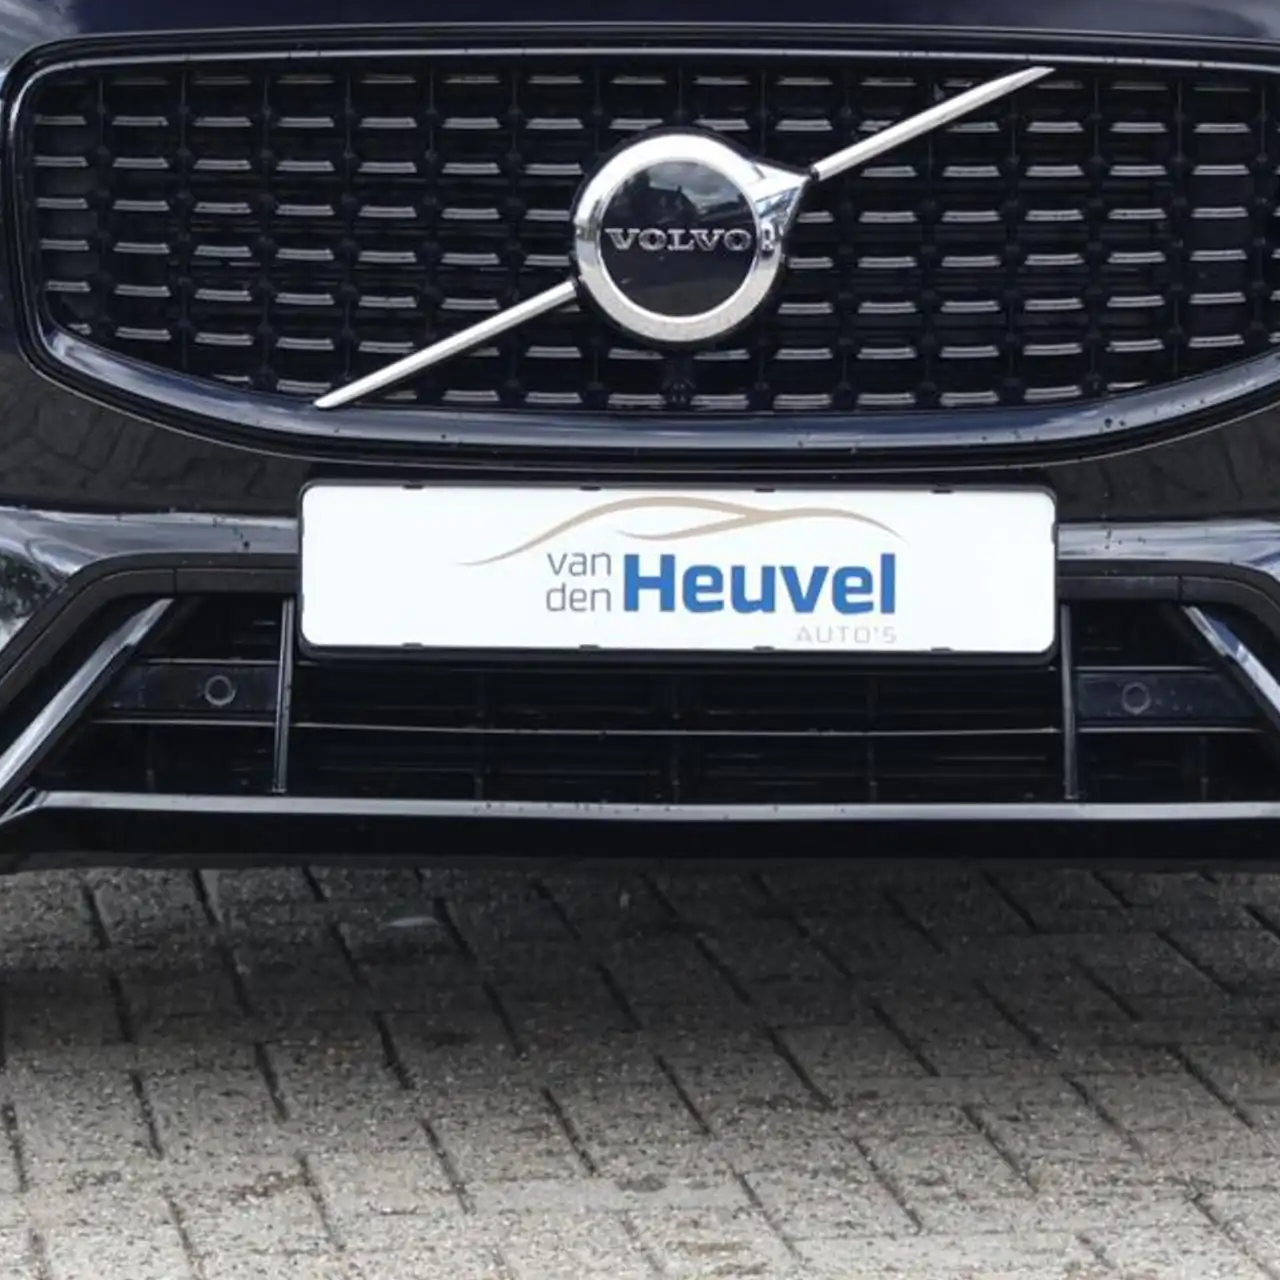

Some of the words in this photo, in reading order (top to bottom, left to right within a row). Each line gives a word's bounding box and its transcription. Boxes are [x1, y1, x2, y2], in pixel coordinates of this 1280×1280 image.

[604, 228, 752, 251] VOLVO
[547, 551, 612, 577] van
[624, 553, 897, 615] Heuvel
[546, 582, 612, 613] den
[796, 626, 898, 644] AUTO'S
